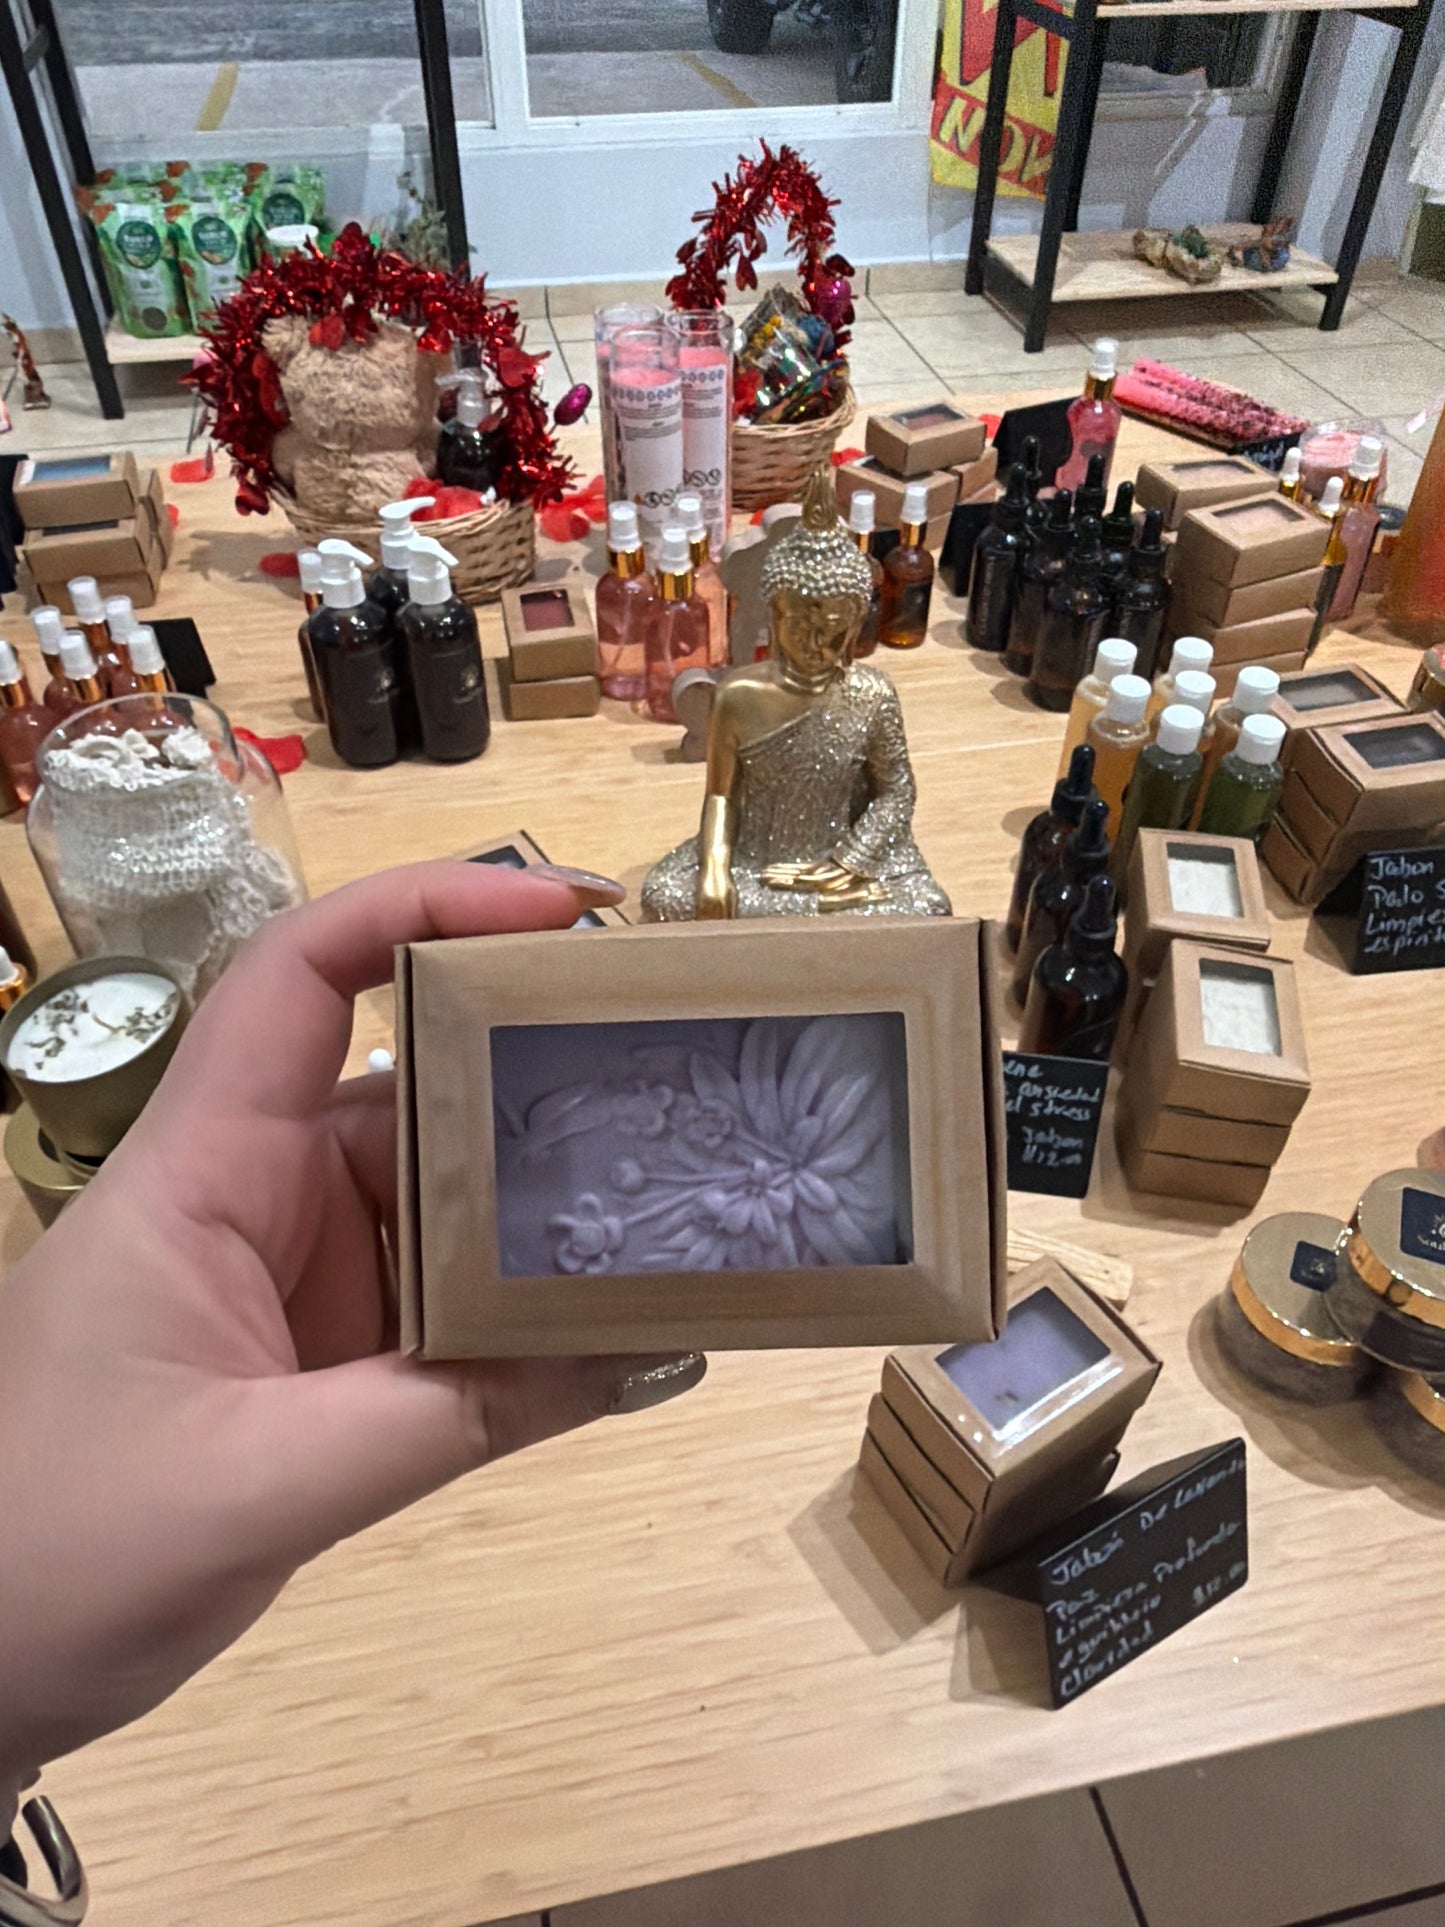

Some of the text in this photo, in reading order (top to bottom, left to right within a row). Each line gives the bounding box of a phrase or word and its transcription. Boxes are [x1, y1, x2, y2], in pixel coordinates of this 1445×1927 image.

[1367, 883, 1424, 909] Palo
[1003, 1060, 1043, 1078] ene
[1046, 1588, 1099, 1622] Paz
